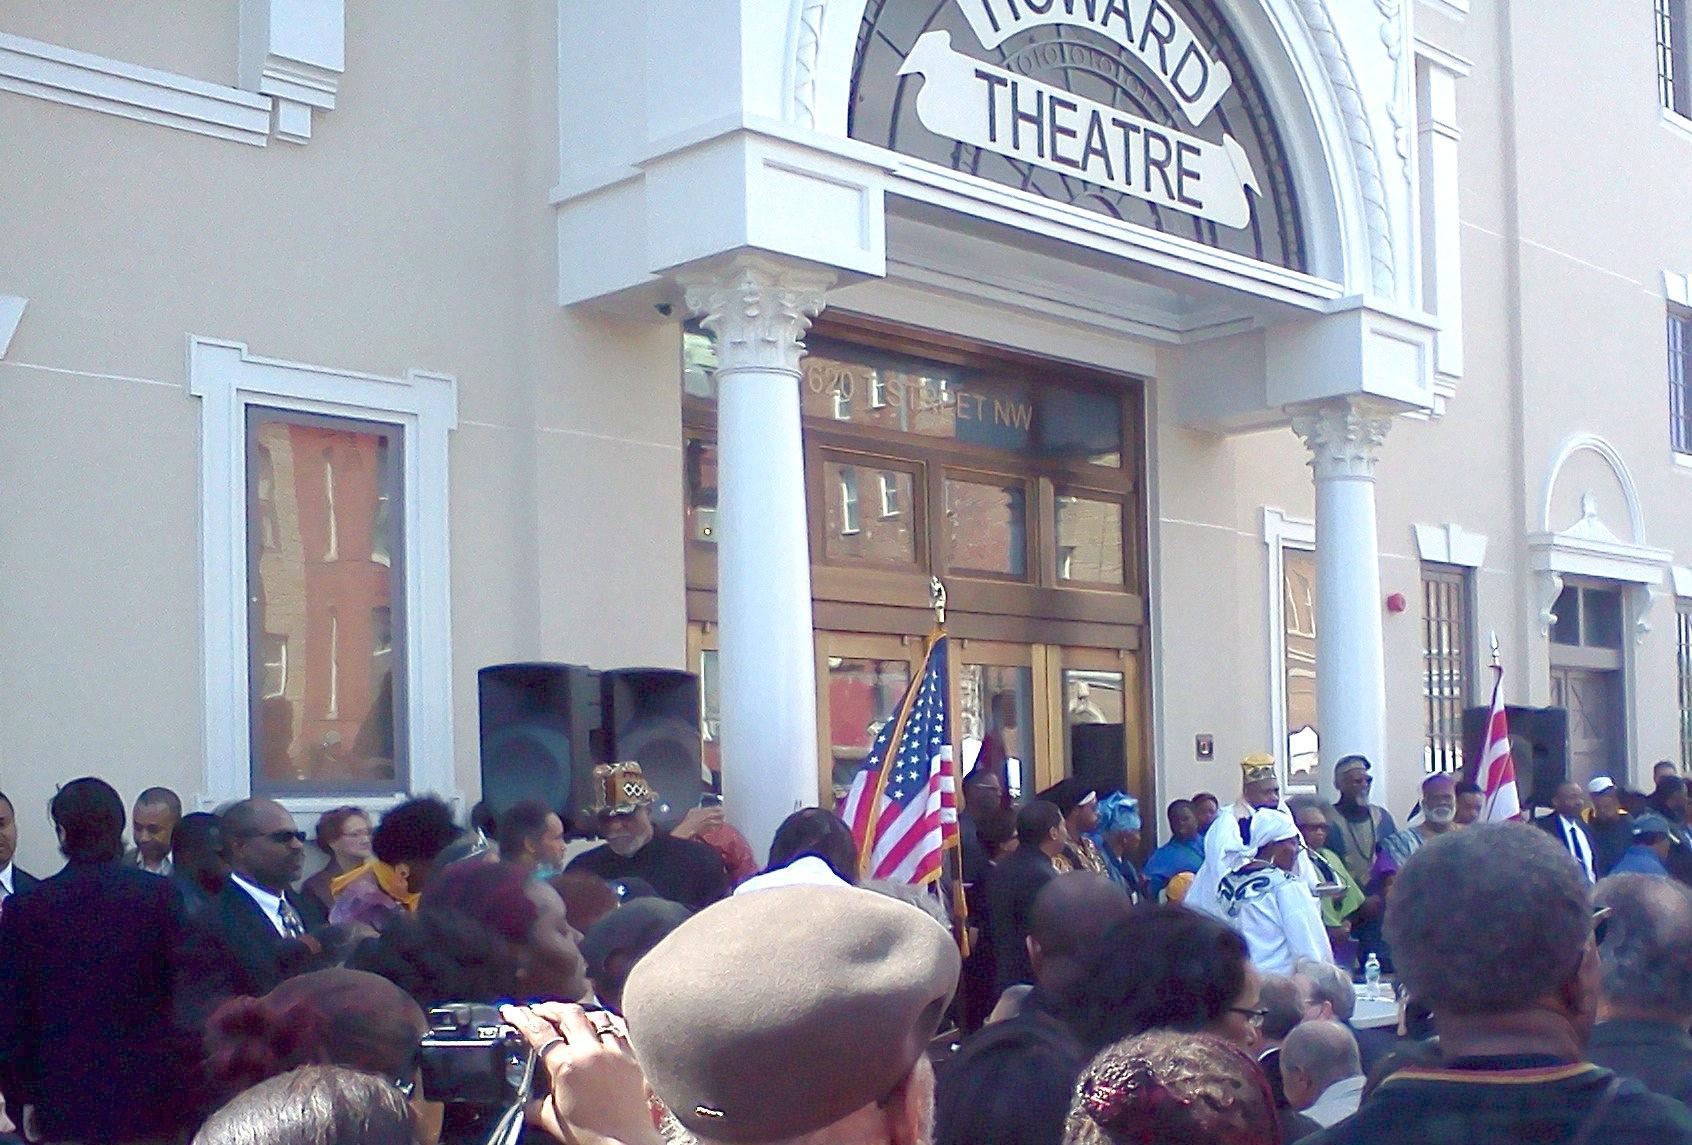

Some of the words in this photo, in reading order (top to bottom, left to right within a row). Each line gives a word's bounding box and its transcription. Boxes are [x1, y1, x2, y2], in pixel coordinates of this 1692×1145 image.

[980, 0, 1208, 103] ARD
[974, 68, 1204, 209] THEATRE
[808, 366, 854, 398] 620
[886, 379, 987, 421] STET
[993, 399, 1033, 431] NW
